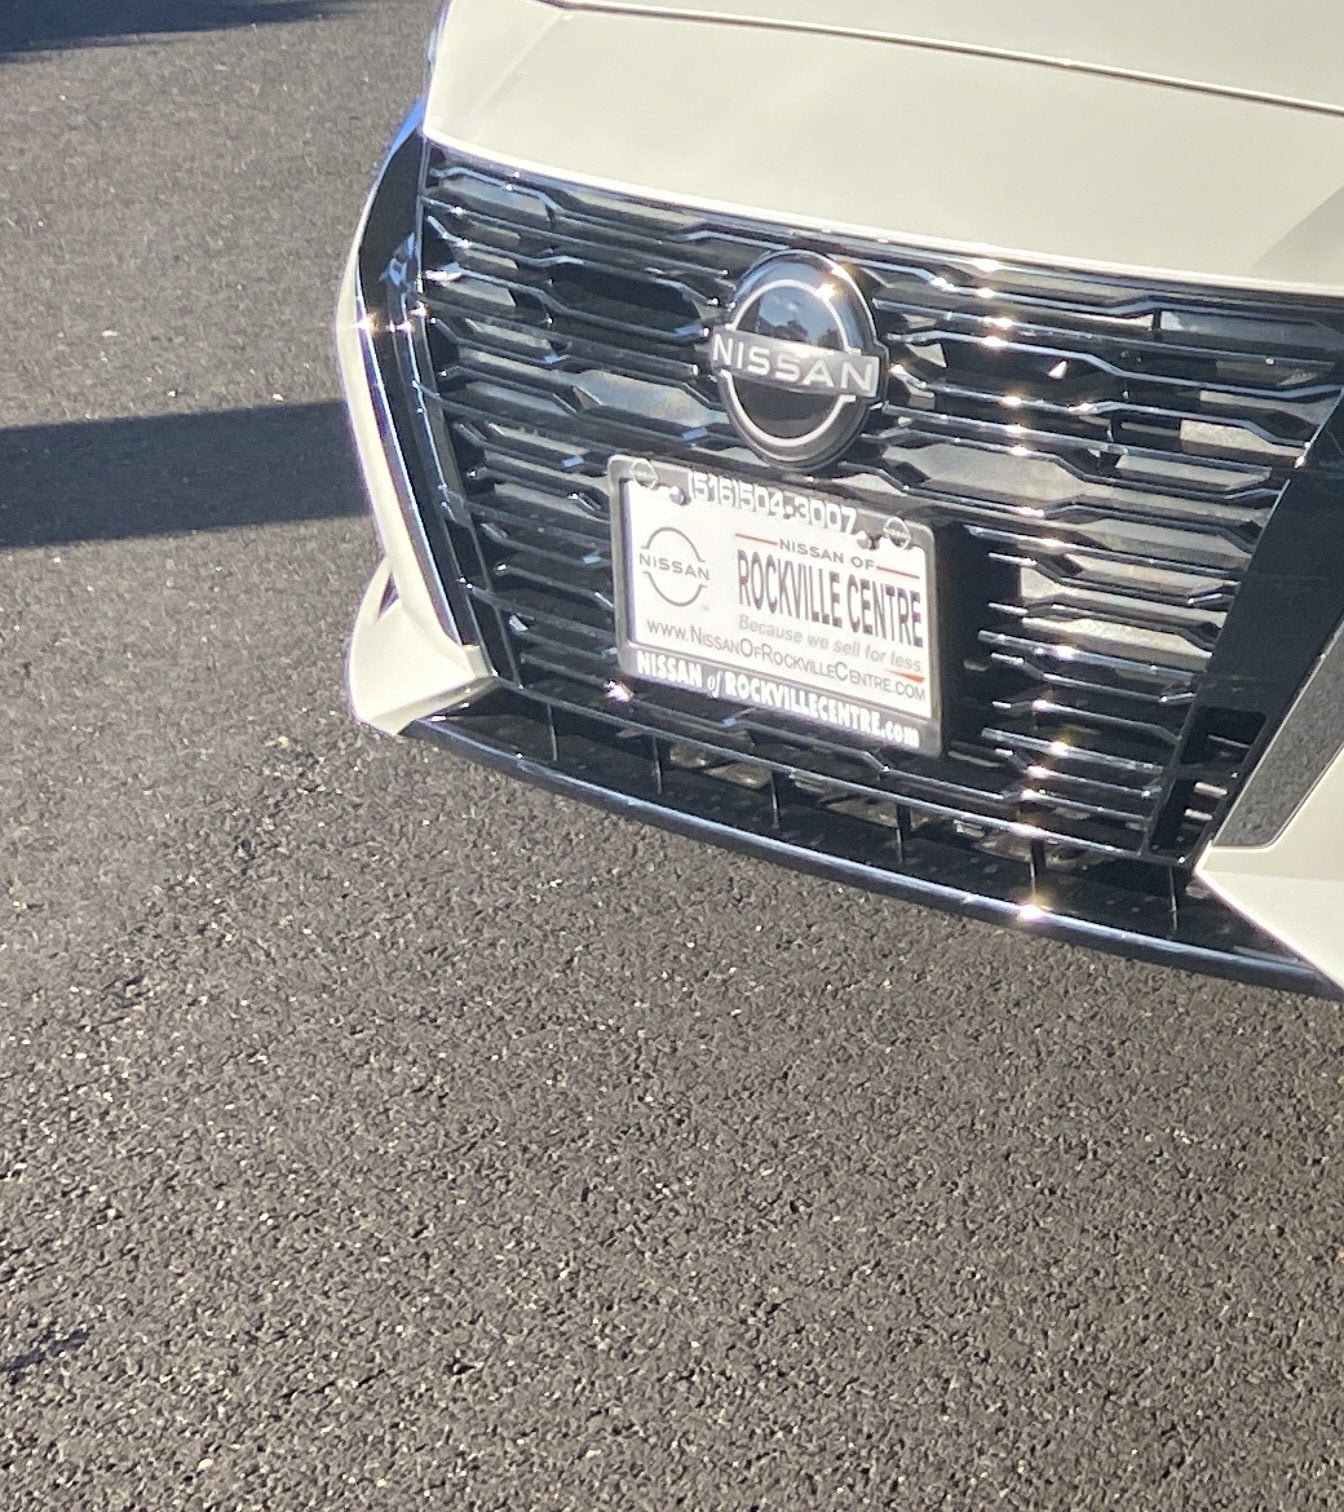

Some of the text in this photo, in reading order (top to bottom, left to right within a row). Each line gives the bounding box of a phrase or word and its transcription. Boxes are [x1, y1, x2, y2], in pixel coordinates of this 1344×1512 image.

[711, 335, 875, 392] NISSAN
[640, 552, 710, 581] NISSAN
[780, 539, 875, 570] NISSAN OF
[737, 549, 923, 648] ROCKVILLE CENTRE
[739, 614, 922, 672] Because we sell for less
[637, 650, 703, 688] NISSAN
[707, 671, 723, 698] of
